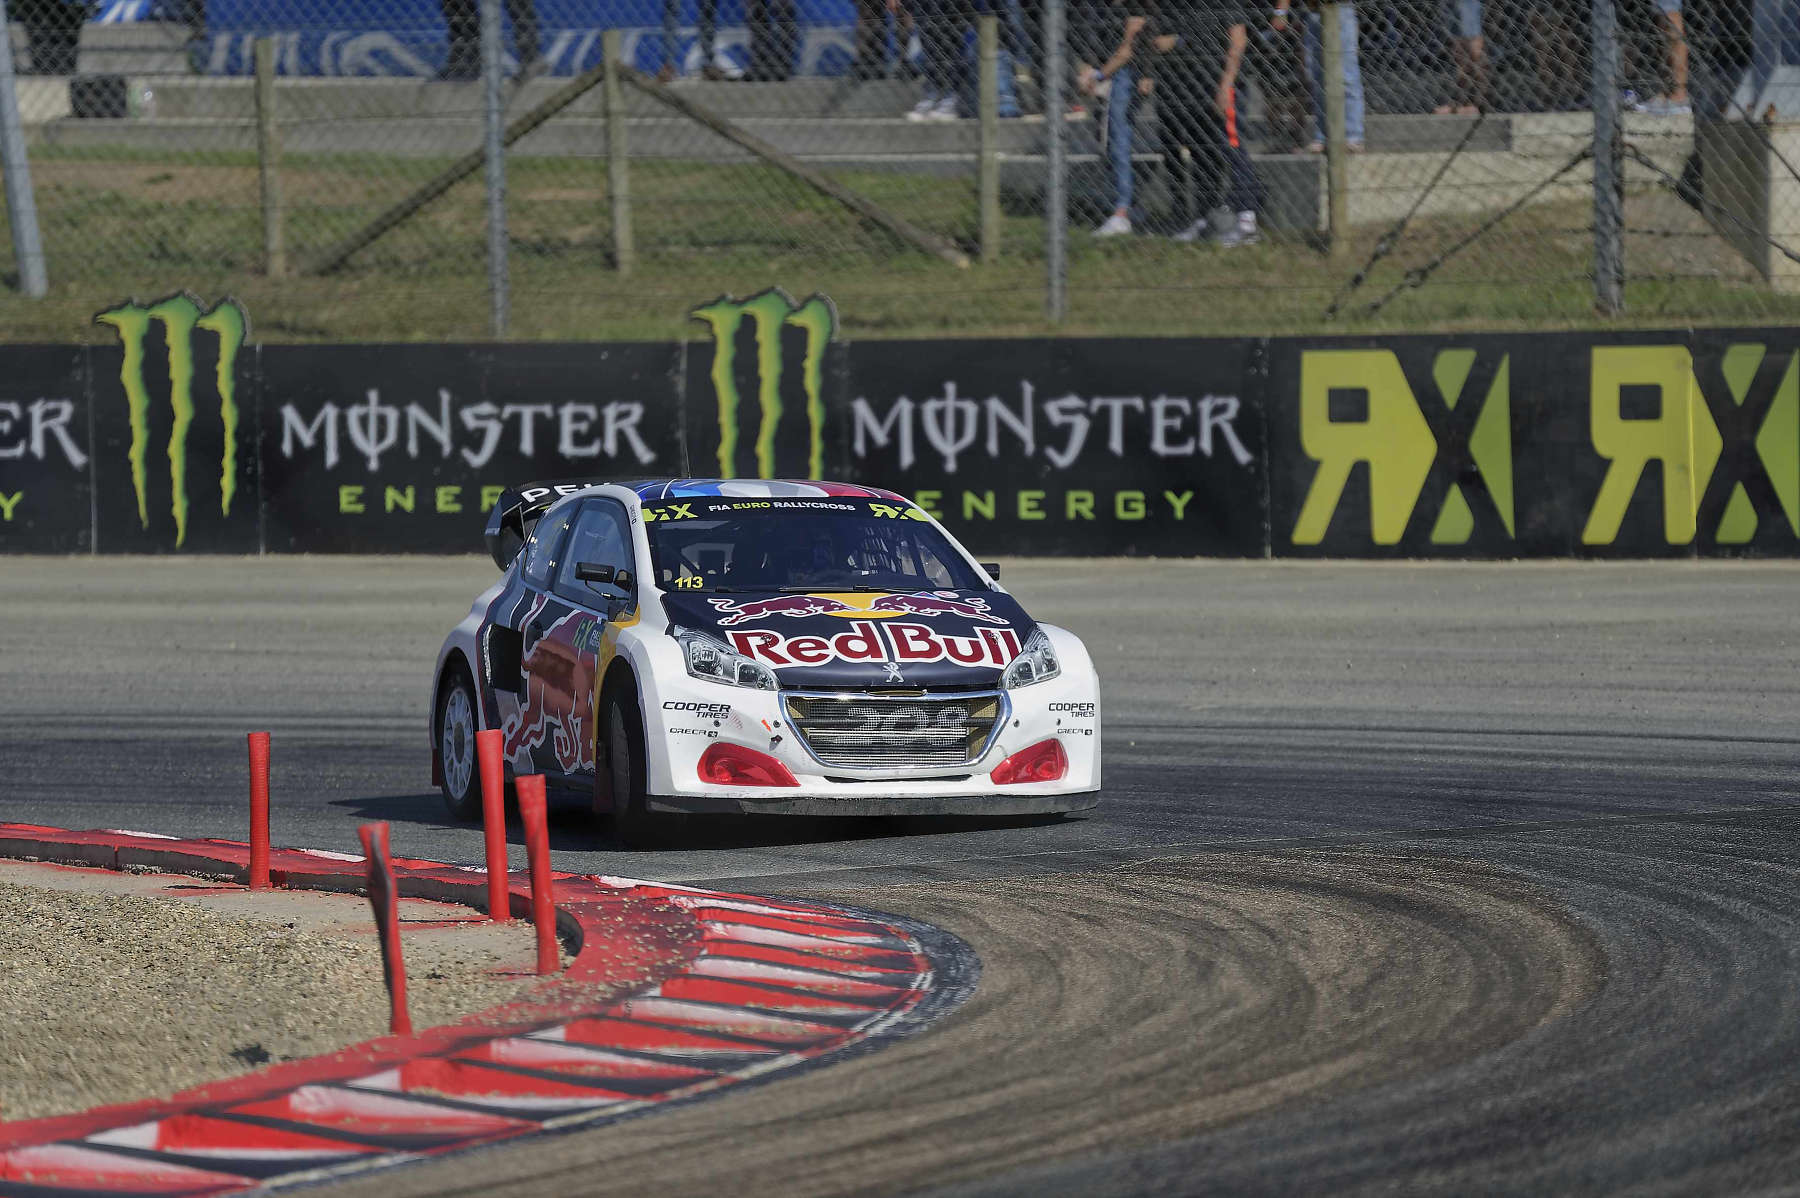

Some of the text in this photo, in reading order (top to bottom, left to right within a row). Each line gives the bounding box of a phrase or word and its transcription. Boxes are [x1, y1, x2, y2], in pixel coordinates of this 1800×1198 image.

[280, 388, 657, 472] MONSTER
[851, 380, 1254, 473] MONSTER
[773, 502, 856, 511] RALLYCROSS
[674, 576, 704, 589] 113
[727, 622, 1021, 667] Red Bull
[663, 701, 731, 713] COOPER
[1048, 702, 1095, 711] COOPER
[696, 711, 729, 719] TIRES
